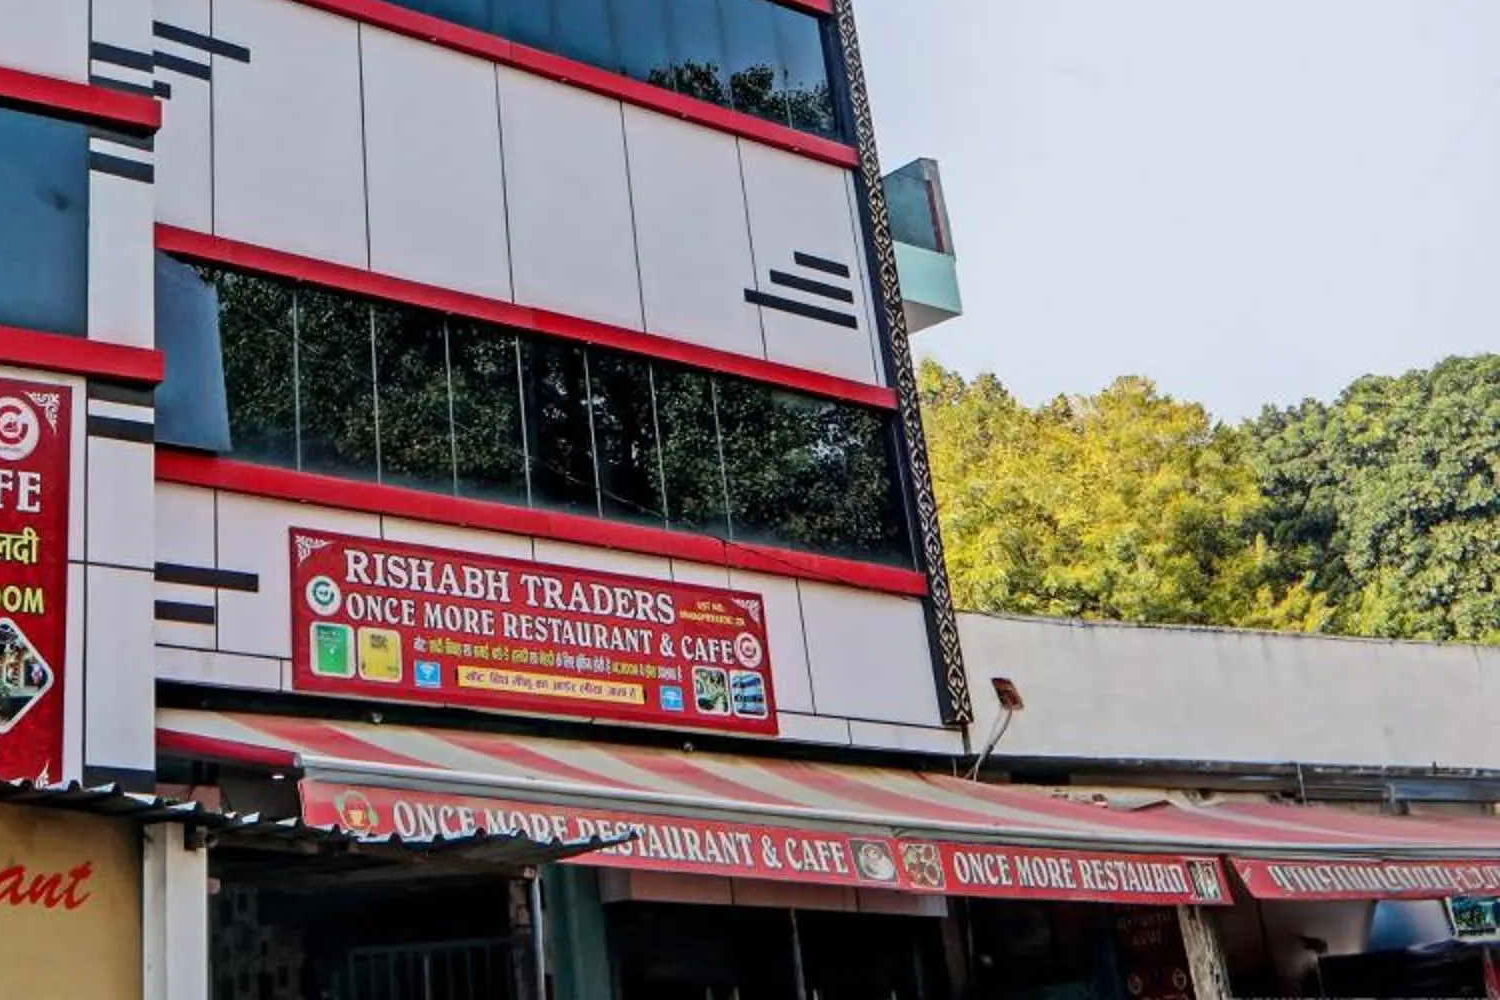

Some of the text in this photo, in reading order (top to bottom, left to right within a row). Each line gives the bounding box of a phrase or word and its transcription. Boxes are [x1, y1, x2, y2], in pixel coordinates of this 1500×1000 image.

[344, 549, 675, 625] RISHABH TRADERS
[346, 593, 416, 627] ONCE
[424, 602, 495, 636] MORE
[502, 612, 653, 656] RESTAURANT
[659, 632, 676, 658] &
[681, 635, 735, 665] CAFE
[393, 799, 476, 838] ONCE
[760, 834, 783, 869] &
[784, 837, 849, 874] CAFE
[953, 851, 1013, 887] ONCE
[1014, 855, 1077, 890] MORE
